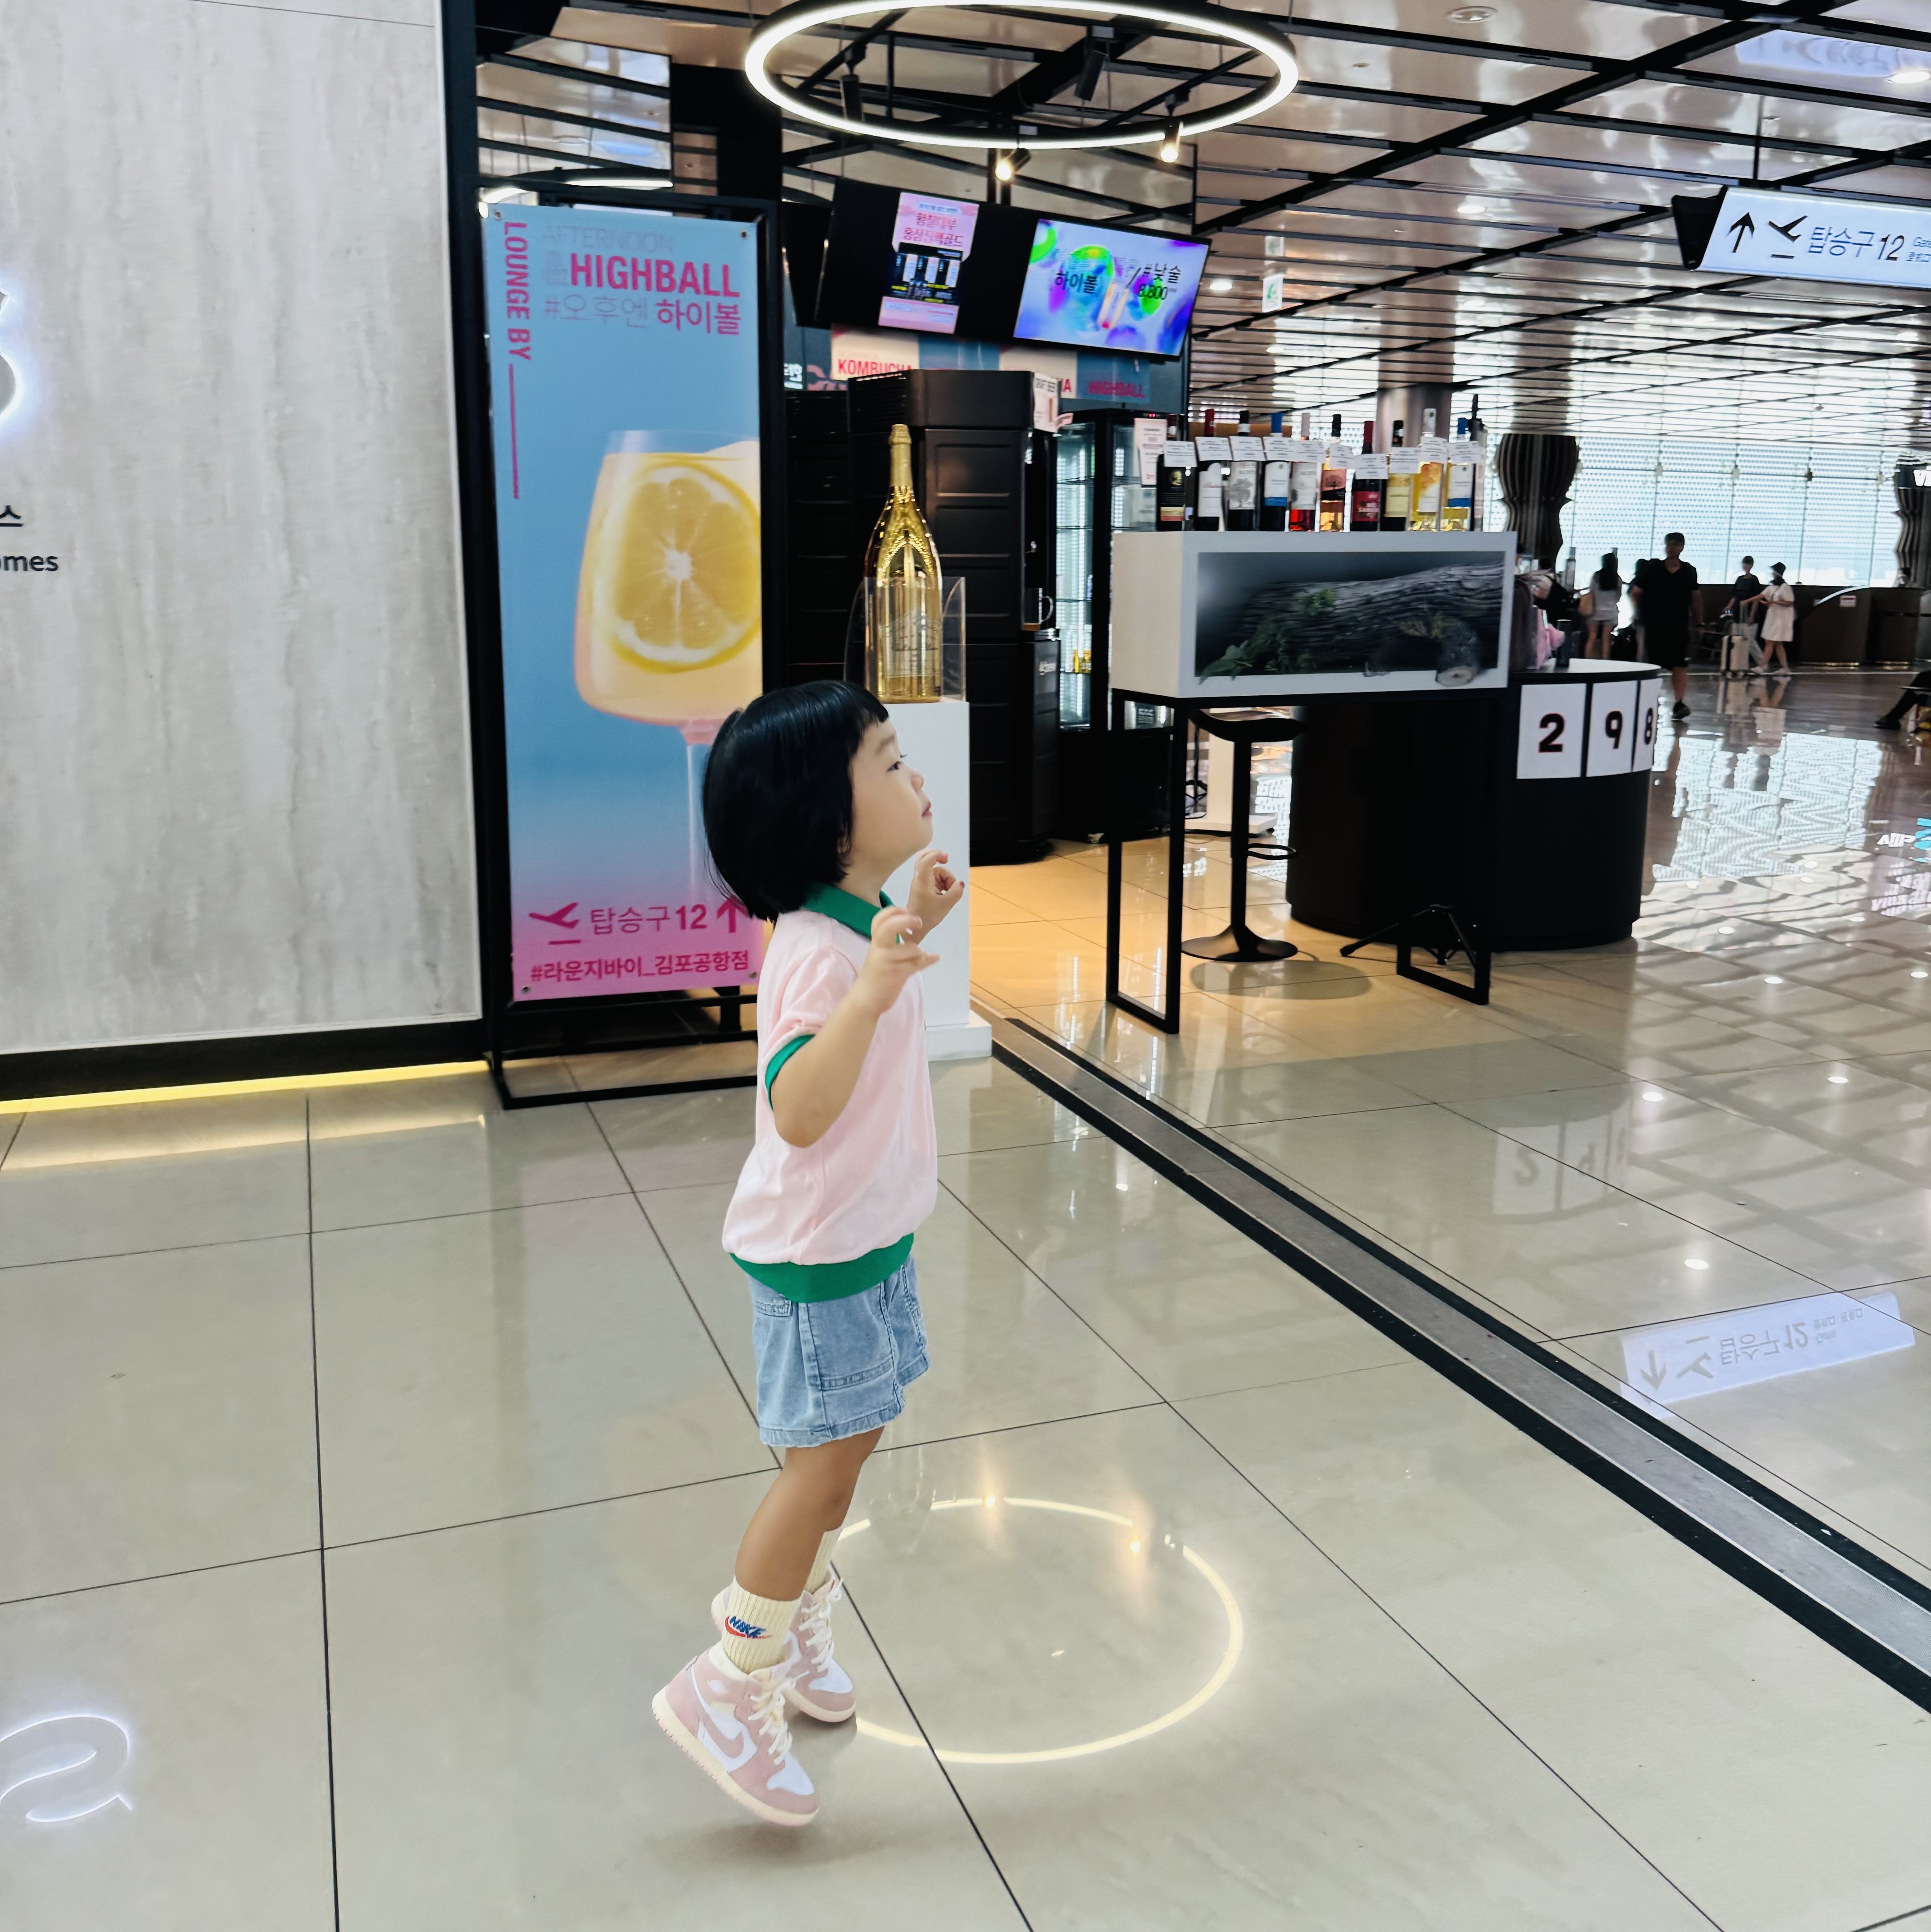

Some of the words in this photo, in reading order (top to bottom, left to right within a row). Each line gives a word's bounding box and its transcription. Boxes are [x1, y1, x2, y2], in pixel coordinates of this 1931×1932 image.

[503, 221, 530, 320] LOUNGE
[570, 252, 740, 297] HIGHBALL
[656, 299, 742, 335] 하이볼
[507, 328, 532, 361] BY
[0, 555, 59, 572] mes
[530, 950, 749, 982] #라운지바이_김포공항점
[729, 1616, 766, 1638] NIKE
